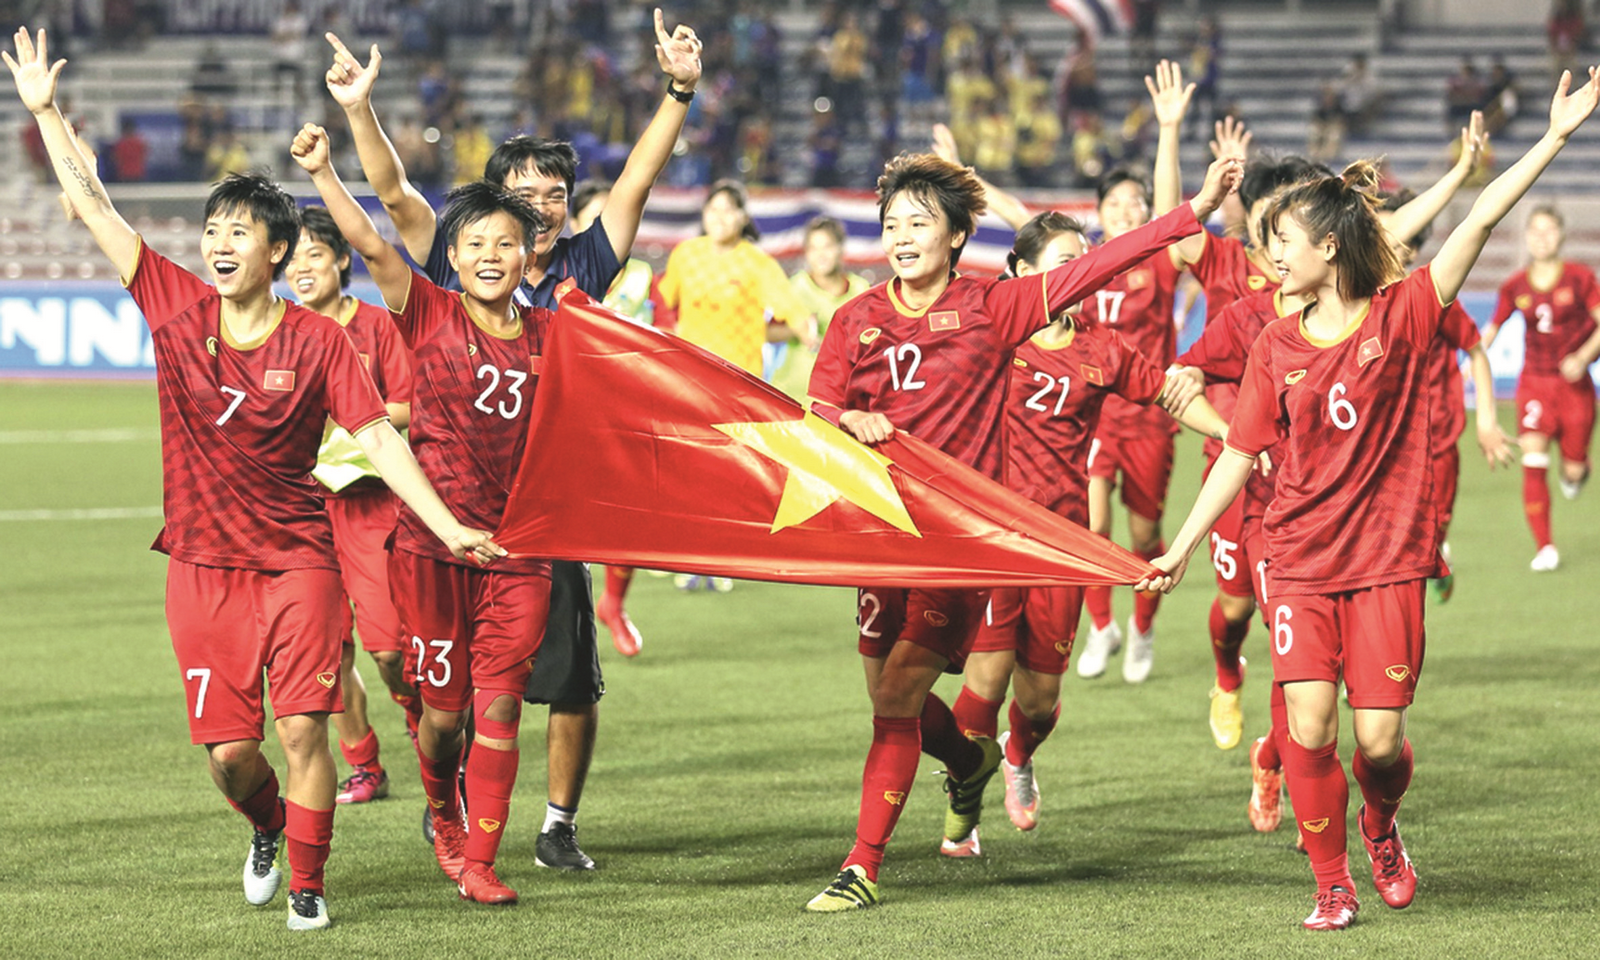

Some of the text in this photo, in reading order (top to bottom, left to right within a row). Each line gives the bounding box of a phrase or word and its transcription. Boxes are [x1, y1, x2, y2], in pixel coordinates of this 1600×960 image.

[1095, 289, 1126, 324] 17
[1535, 303, 1553, 334] 2
[0, 297, 156, 367] NN
[474, 364, 528, 420] 23
[882, 342, 926, 392] 12
[215, 385, 247, 427] 7
[1025, 371, 1070, 416] 21
[1327, 381, 1358, 431] 6
[1522, 399, 1542, 429] 2
[1211, 531, 1238, 581] 25
[859, 588, 882, 639] 2
[1275, 604, 1293, 656] 6
[411, 635, 453, 688] 23
[186, 668, 211, 719] 7
